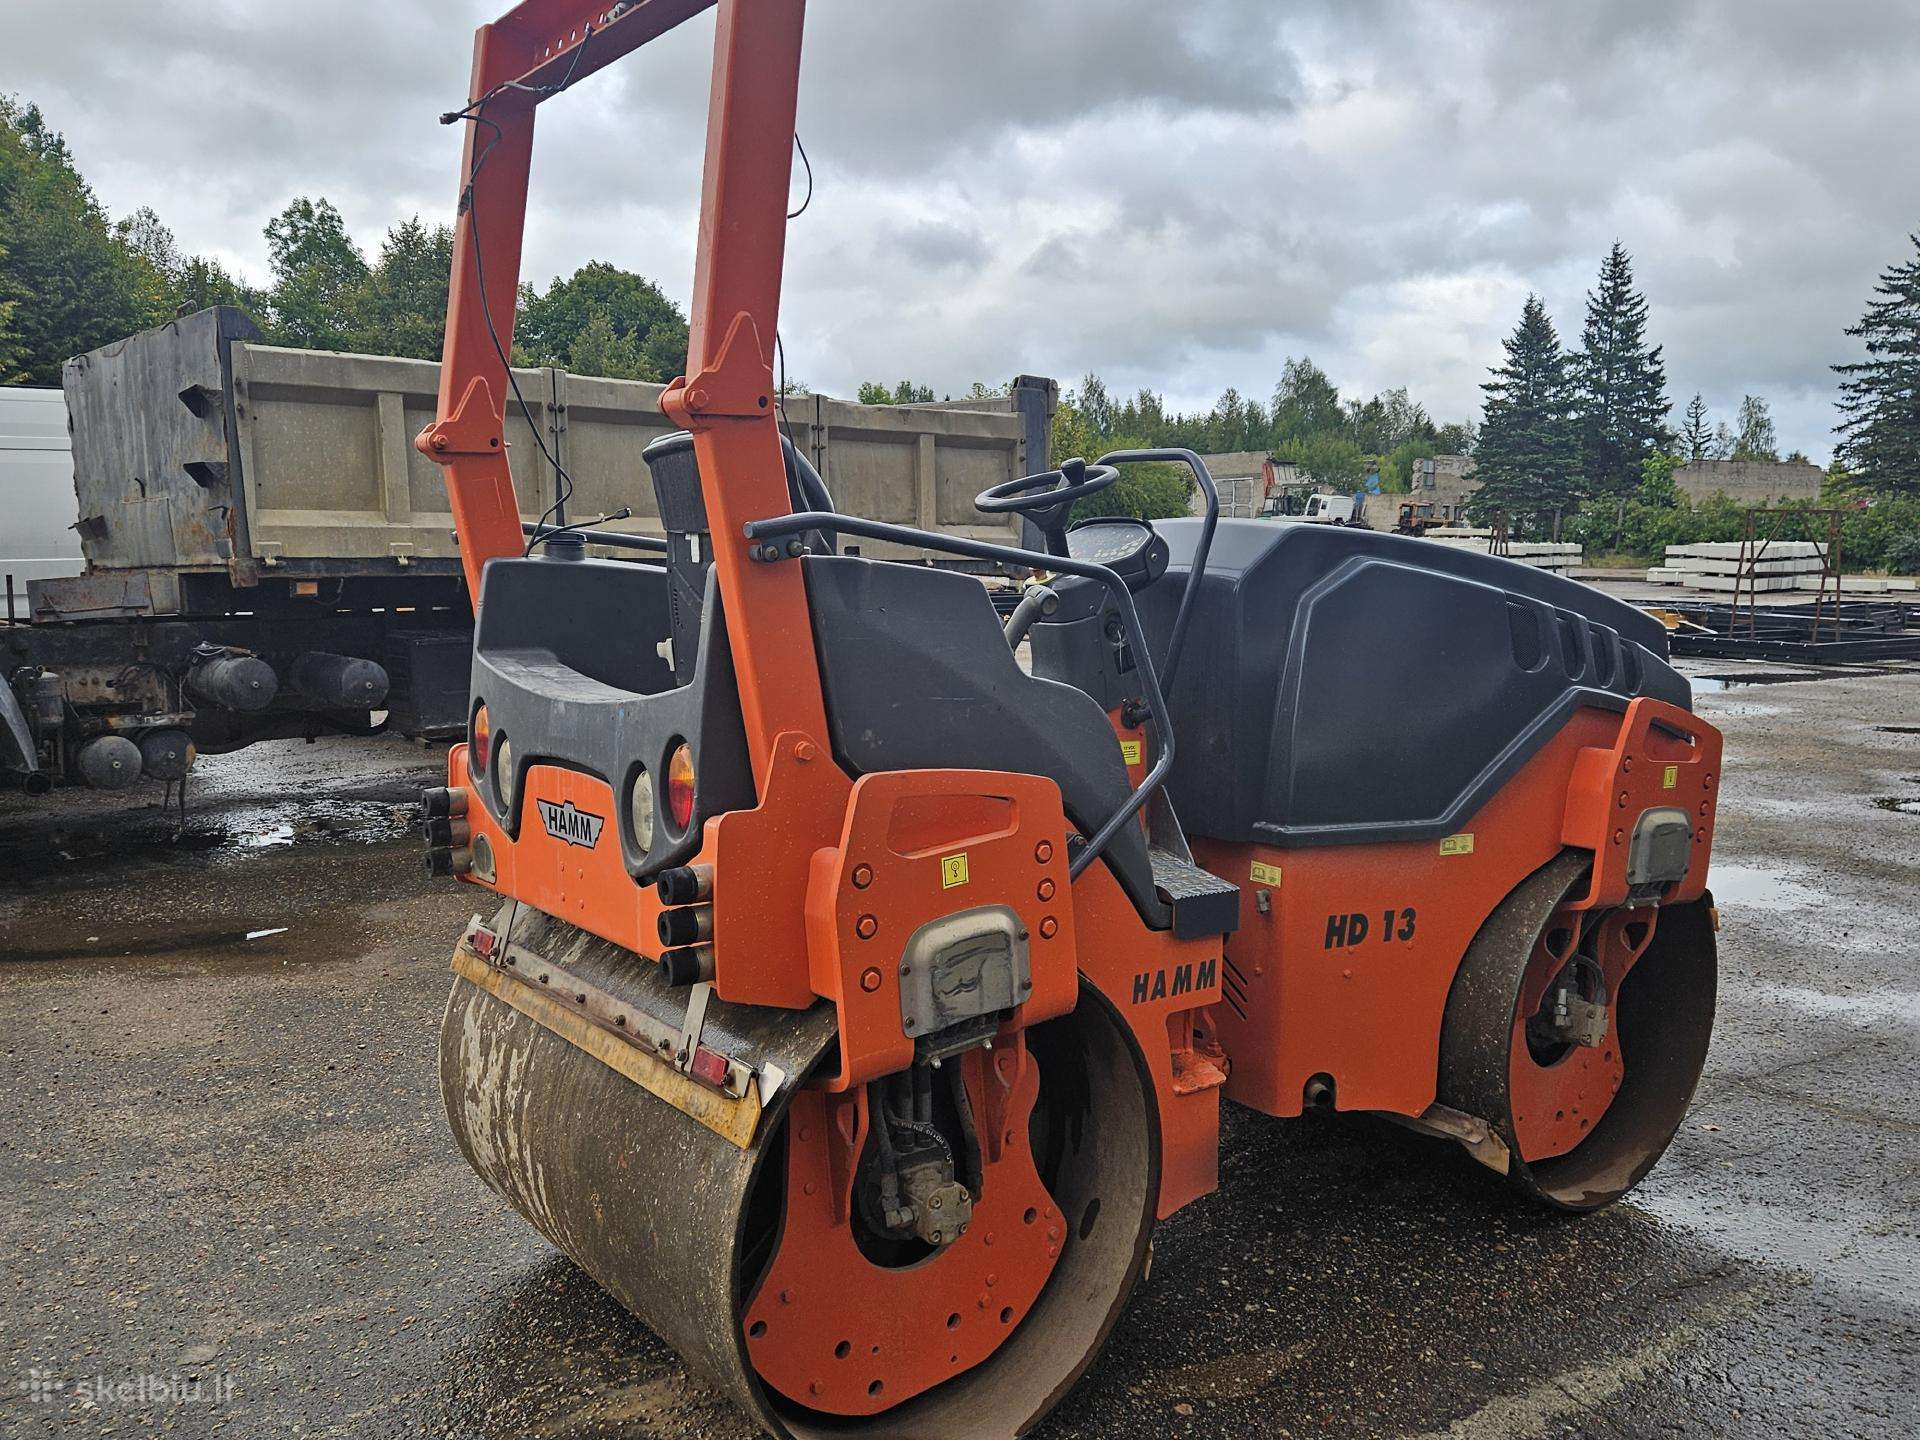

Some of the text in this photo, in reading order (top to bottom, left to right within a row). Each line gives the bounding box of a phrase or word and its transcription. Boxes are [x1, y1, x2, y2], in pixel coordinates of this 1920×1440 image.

[548, 807, 593, 843] HAMM
[1324, 907, 1417, 950] HD 13
[1132, 959, 1216, 1005] HAMM
